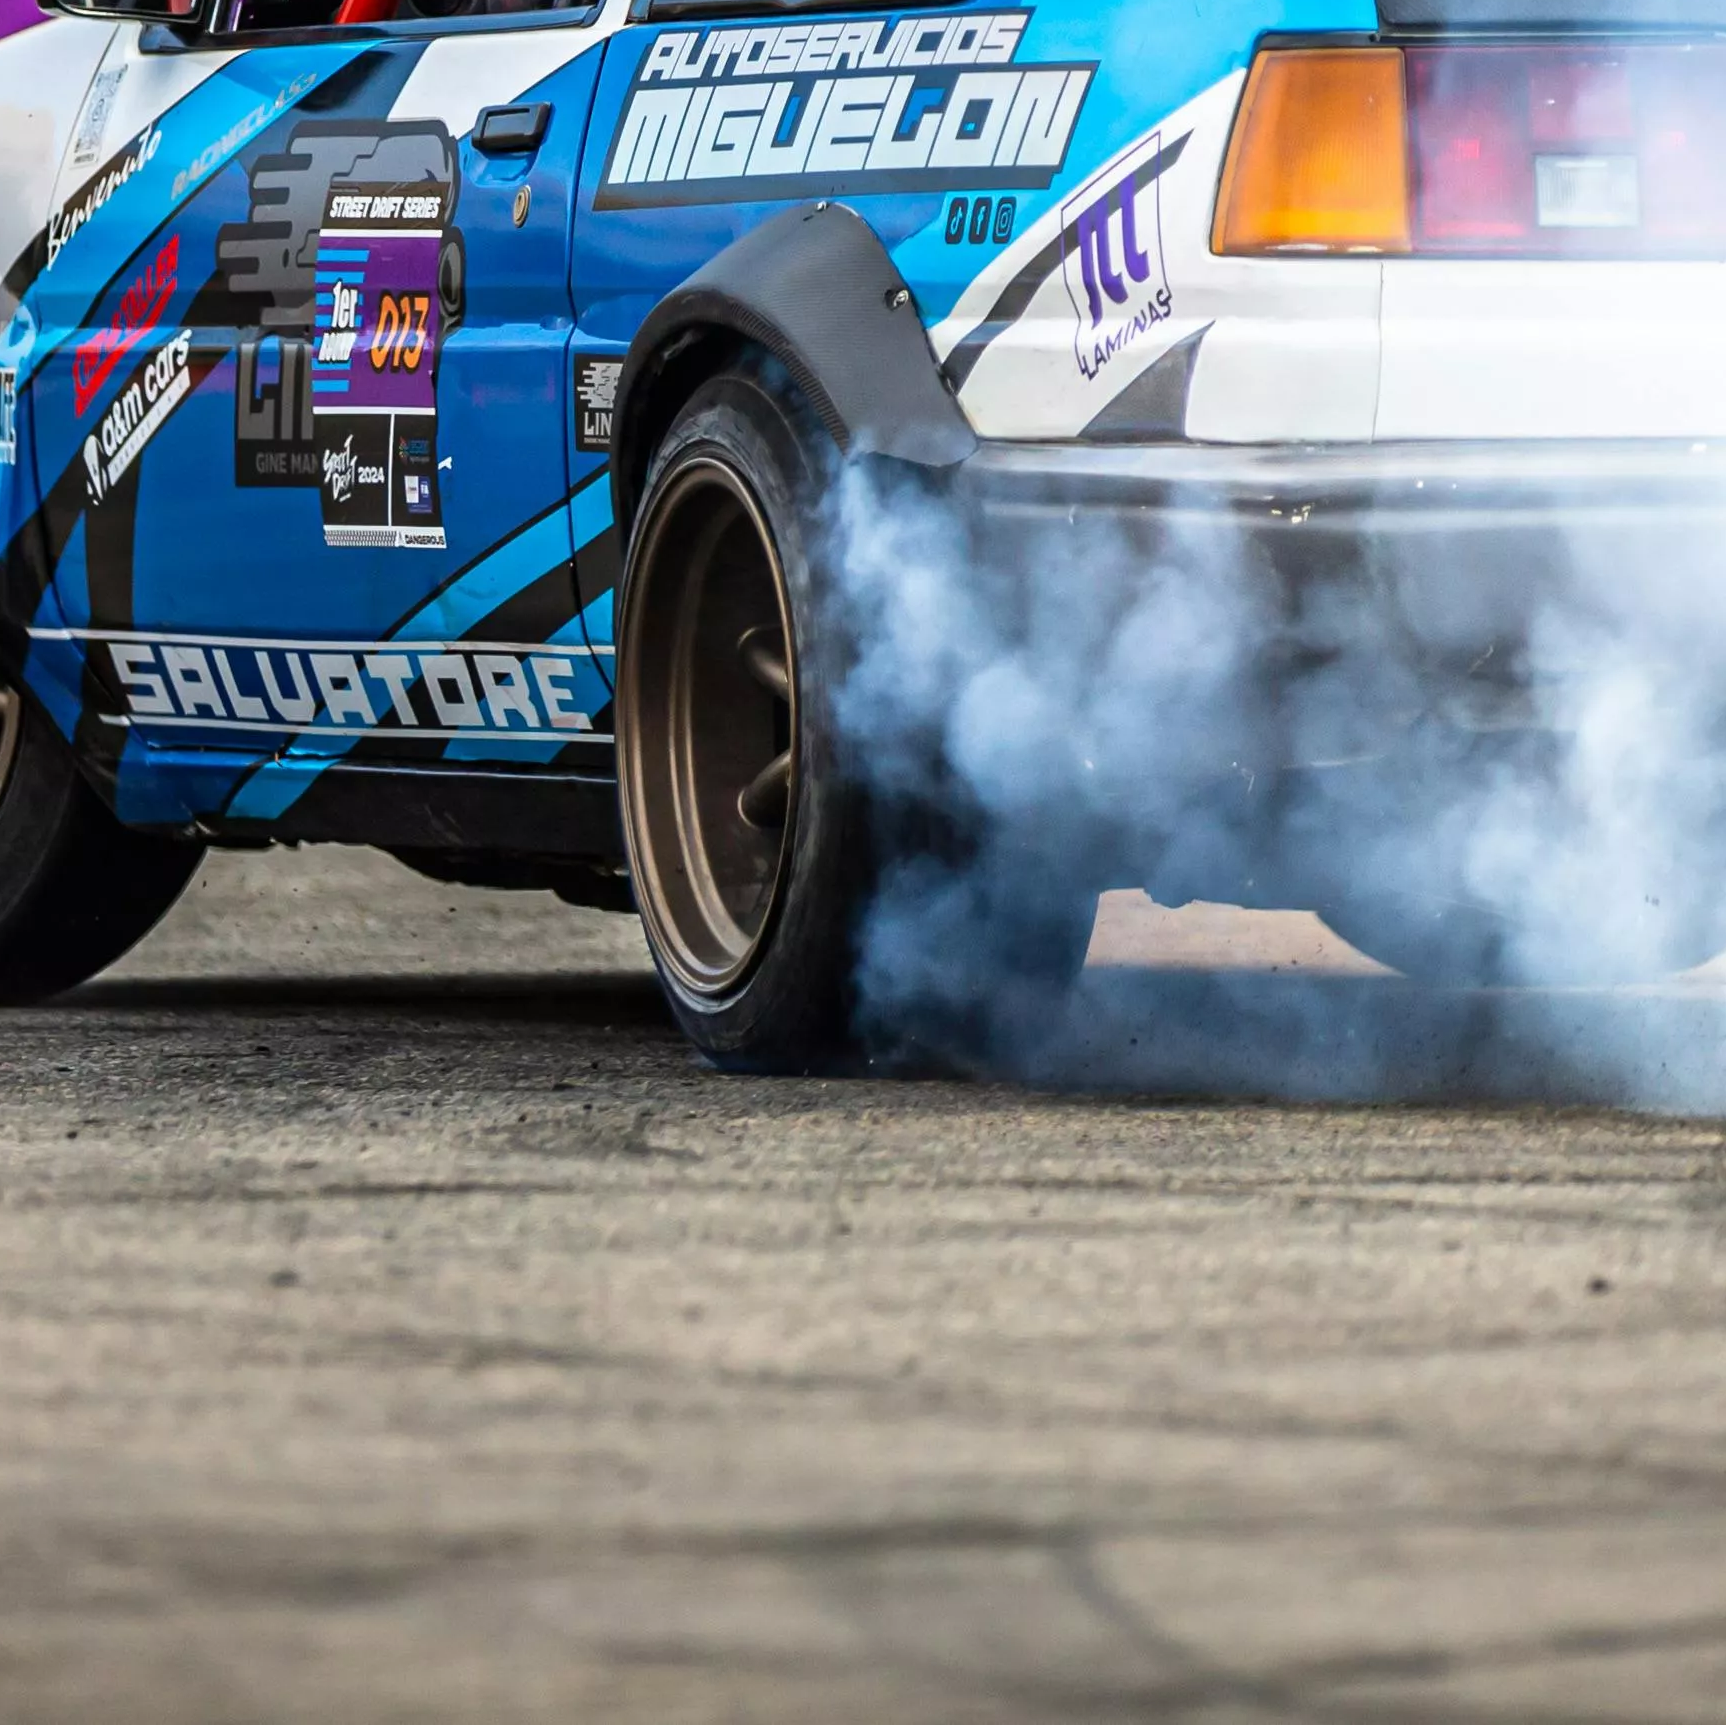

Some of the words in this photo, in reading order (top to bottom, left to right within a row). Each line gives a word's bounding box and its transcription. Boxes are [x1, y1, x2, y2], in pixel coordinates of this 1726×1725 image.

[640, 14, 1024, 82] AUTOSERVICIOS
[607, 69, 1092, 184] MIGUELON
[330, 196, 373, 218] STREET
[369, 196, 404, 218] DRIFT
[402, 196, 442, 219] SERIES
[332, 281, 358, 328] 1er
[370, 294, 429, 369] 013
[102, 381, 144, 457] a&m
[144, 328, 193, 403] cars
[358, 465, 385, 484] 2024
[404, 534, 446, 546] DANGEROUS
[108, 643, 593, 730] SALVATORE
